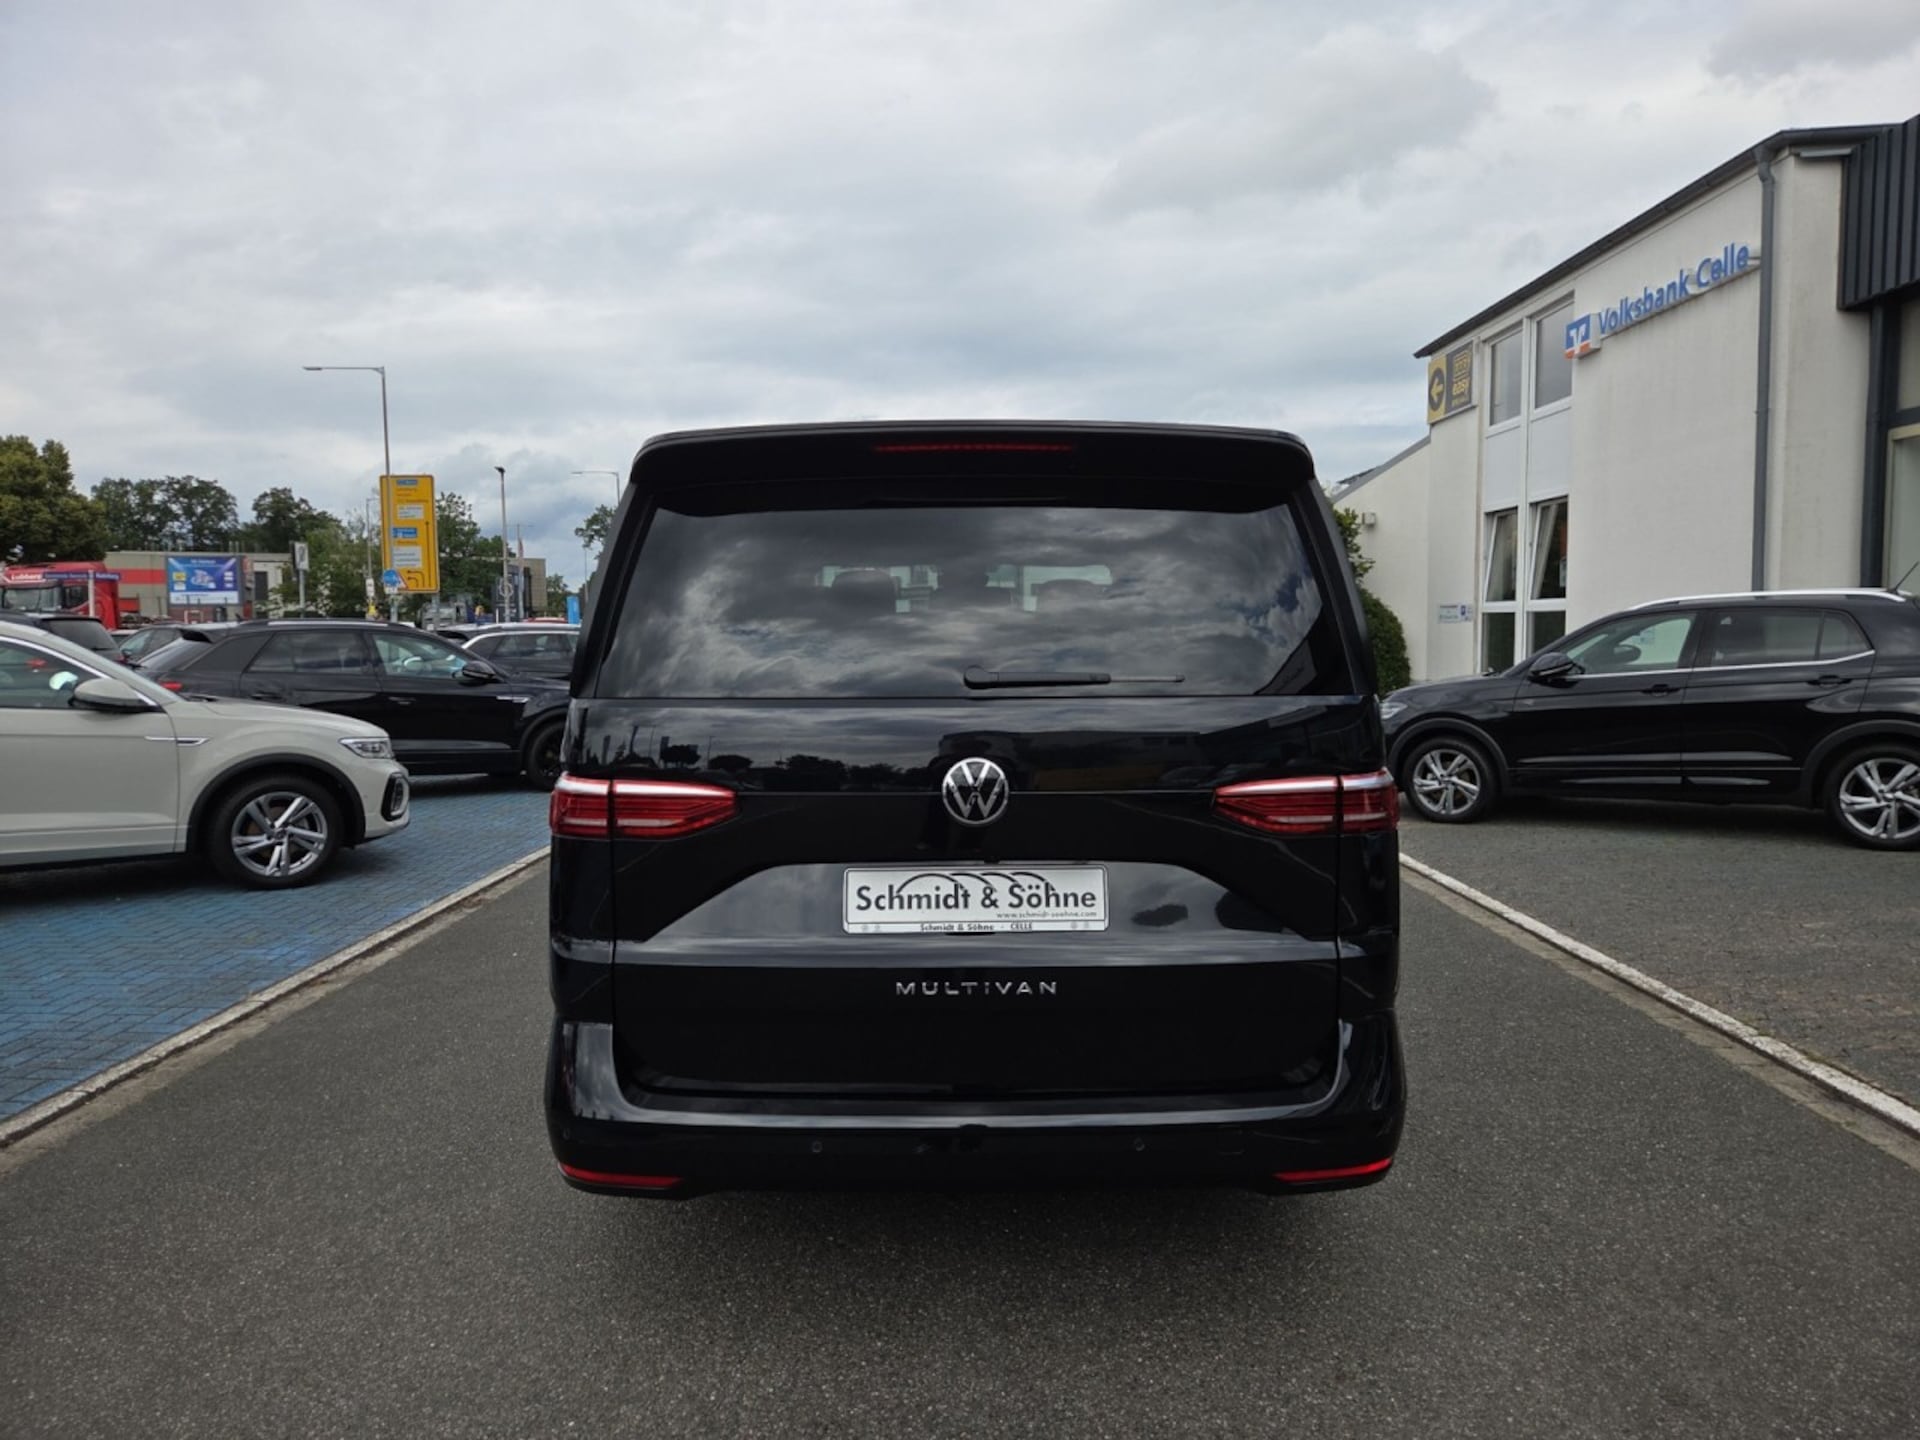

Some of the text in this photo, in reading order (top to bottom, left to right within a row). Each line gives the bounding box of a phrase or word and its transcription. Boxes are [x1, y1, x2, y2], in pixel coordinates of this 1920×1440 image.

[1599, 243, 1749, 335] Volksbank Celle
[856, 882, 1097, 911] Schmidt & Söhne
[920, 923, 954, 933] Schmidt
[967, 922, 995, 932] Söhne
[1010, 921, 1033, 931] CELLE
